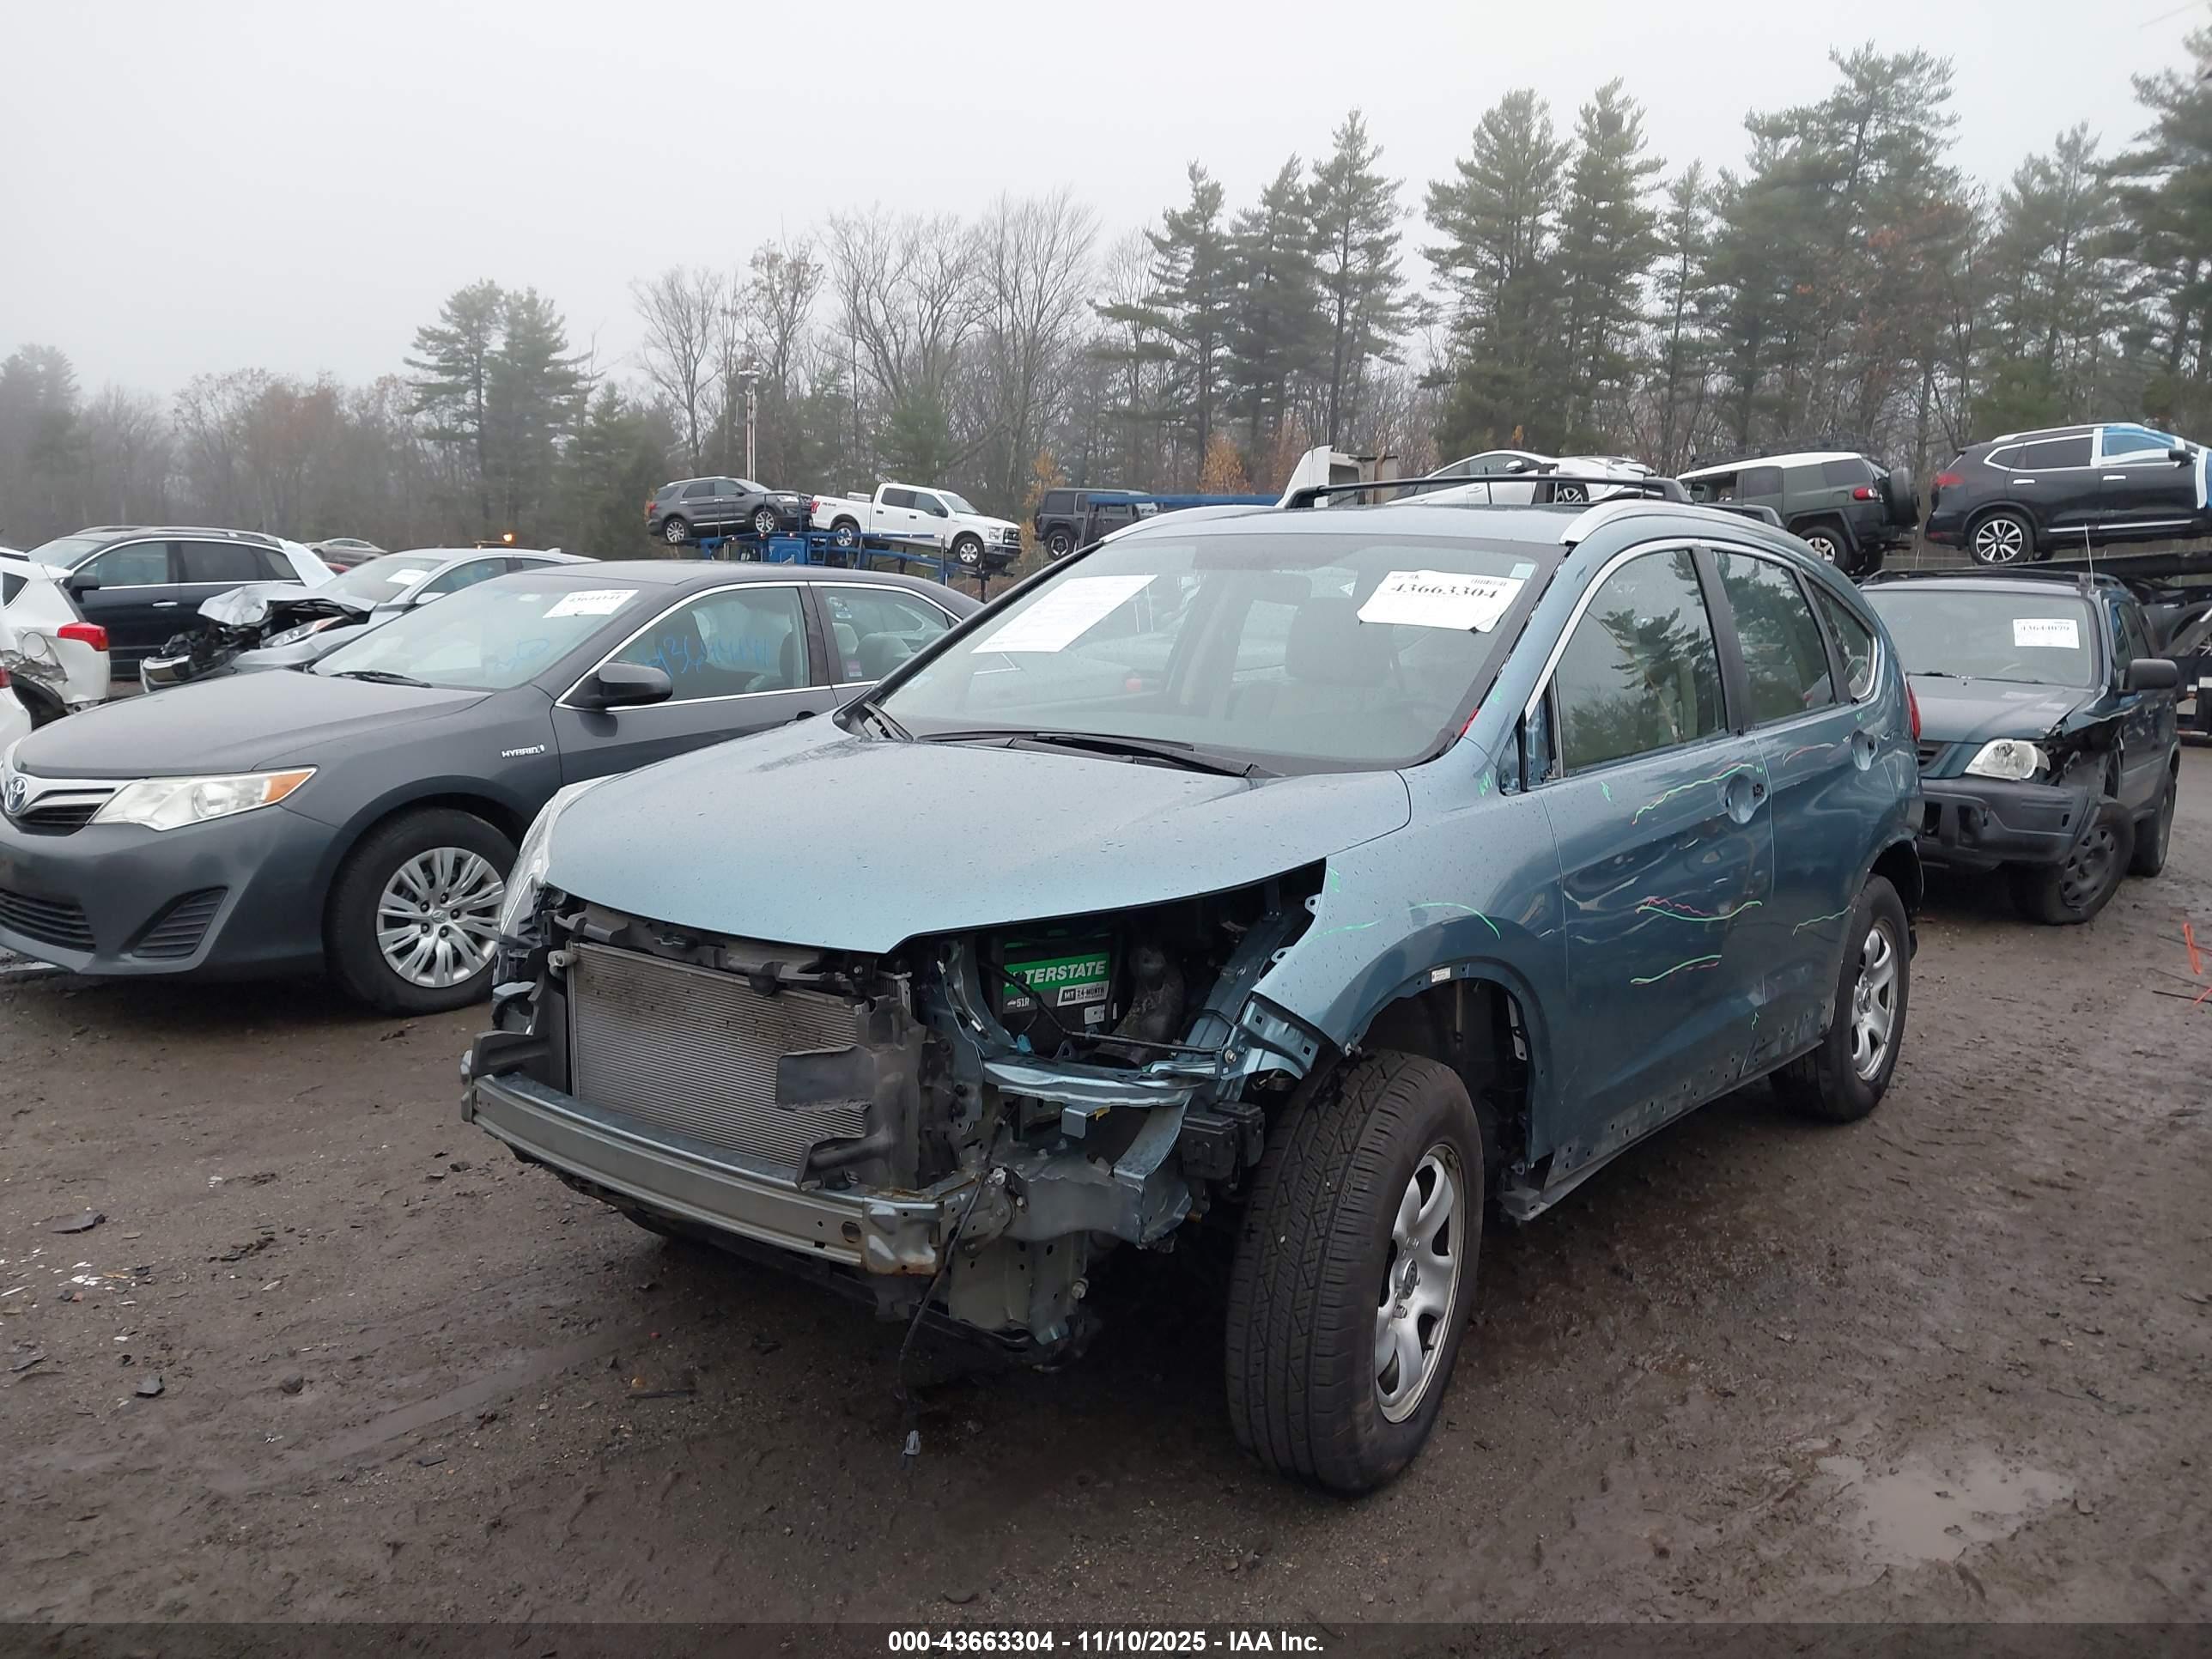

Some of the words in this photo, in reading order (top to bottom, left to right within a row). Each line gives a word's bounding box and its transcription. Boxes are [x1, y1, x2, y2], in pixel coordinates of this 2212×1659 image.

[1390, 583, 1498, 599] 43663304
[501, 745, 541, 758] HYBRID
[1004, 960, 1107, 988] TERSTATE
[1016, 997, 1030, 1008] 51R
